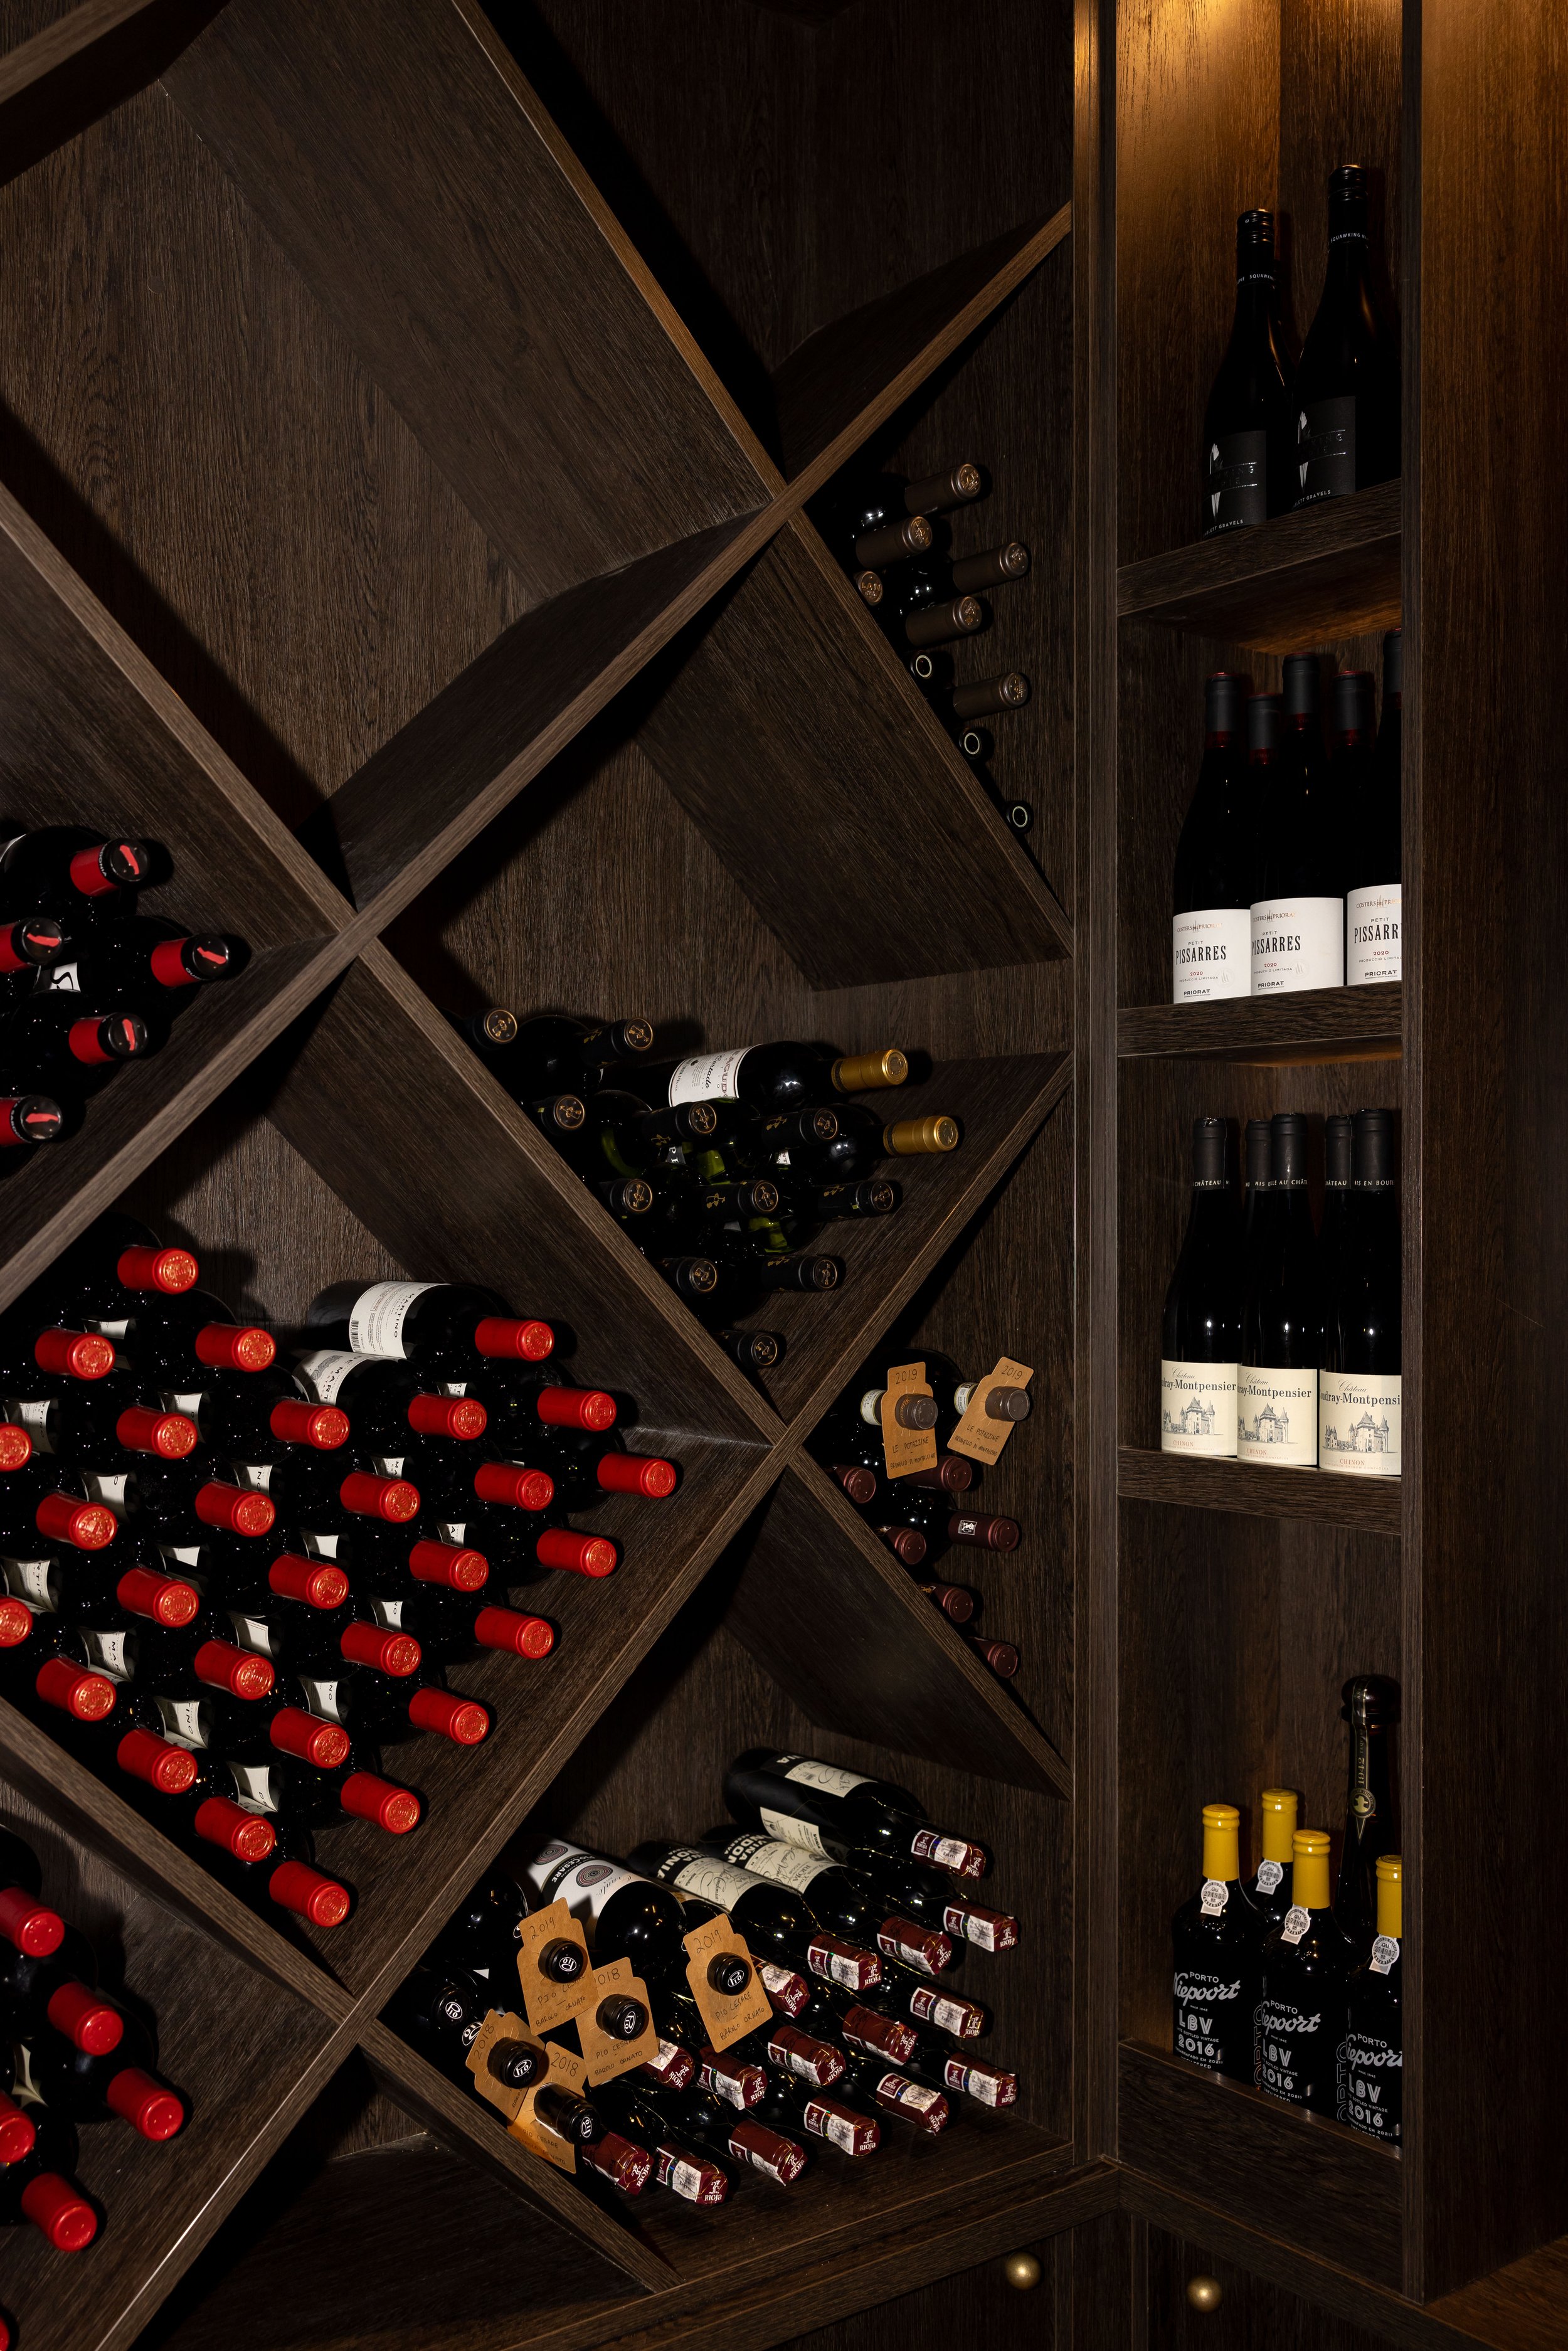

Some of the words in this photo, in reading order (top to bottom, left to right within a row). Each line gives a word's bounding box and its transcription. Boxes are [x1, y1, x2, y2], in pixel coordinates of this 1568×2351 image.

[1330, 232, 1360, 243] SQUAWKING
[1306, 489, 1331, 500] GRAVELS
[1219, 519, 1244, 529] GRAVELS
[861, 581, 881, 593] LAN
[1356, 900, 1376, 908] COSTERS
[1354, 923, 1402, 943] PISSARR
[1251, 935, 1301, 956] PISSARRES
[1176, 945, 1226, 965] PISSARRES
[896, 1369, 918, 1384] 2019
[1002, 1366, 1023, 1380] 2019
[1172, 1366, 1196, 1379] Château
[1245, 1372, 1269, 1386] Château
[1162, 1377, 1236, 1393] dray-Montpensier
[1338, 1379, 1368, 1393] Château
[893, 1444, 899, 1453] LE
[529, 1916, 556, 1940] 2019
[693, 1929, 722, 1954] 2019
[561, 1958, 575, 1970] PIO
[594, 1968, 620, 1985] 018
[728, 1971, 743, 1986] PIO
[1190, 1972, 1219, 1983] PORTO
[1173, 1972, 1241, 2007] Niepoort
[538, 1992, 557, 2006] PIO
[447, 2003, 461, 2018] PIO
[536, 2012, 558, 2027] BAROLO
[565, 1996, 586, 2011] ORNATO
[1271, 2000, 1298, 2014] PORTO
[624, 2014, 635, 2030] PIO
[715, 2010, 728, 2022] PIO
[1179, 2009, 1213, 2035] LBV
[719, 2024, 740, 2041] BAROLO
[744, 2007, 765, 2023] ORNATO
[474, 2024, 494, 2060] 2018
[1183, 2030, 1199, 2039] BOTTLED
[1357, 2034, 1387, 2048] PORTO
[1178, 2034, 1215, 2057] 2016
[1263, 2038, 1292, 2067] LBV
[596, 2050, 608, 2059] PIO
[515, 2061, 529, 2076] PIO
[551, 2052, 578, 2077] 2018
[595, 2063, 615, 2076] BAROLO
[620, 2051, 643, 2064] ORNATO
[1262, 2064, 1293, 2090] 2016
[1279, 2067, 1298, 2076] VINTAGE
[1348, 2072, 1381, 2103] LBV
[1348, 2099, 1383, 2127] 2016
[1369, 2104, 1388, 2113] VINTAGE
[582, 2117, 592, 2136] PIO
[537, 2135, 559, 2149] CESARE
